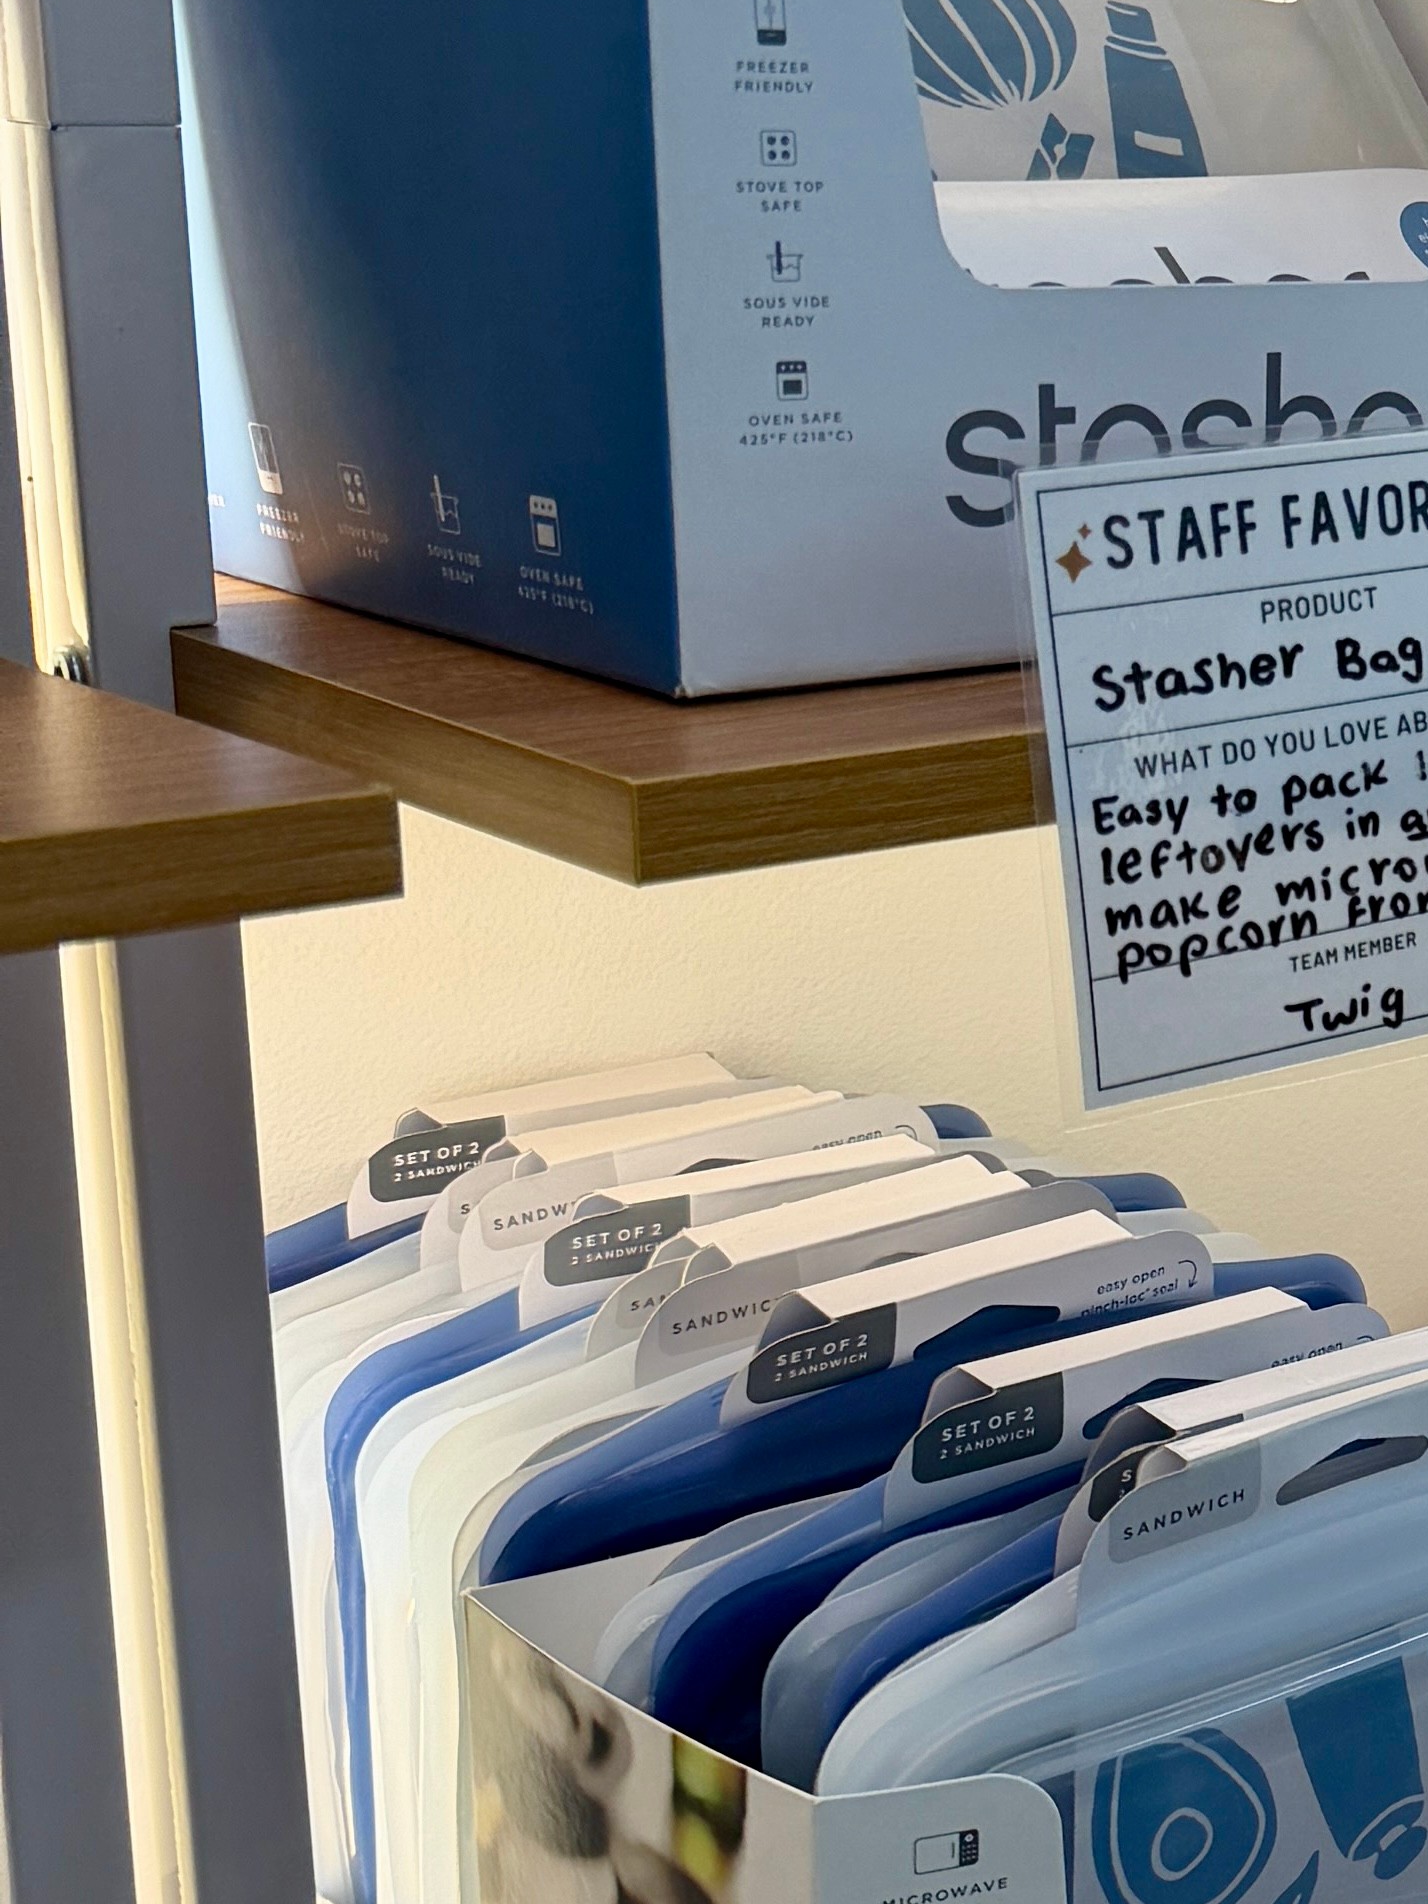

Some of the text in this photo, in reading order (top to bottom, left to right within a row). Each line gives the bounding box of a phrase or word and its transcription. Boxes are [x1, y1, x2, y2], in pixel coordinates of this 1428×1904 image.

[733, 80, 814, 95] FRIENDLY
[734, 60, 810, 75] FREEZER
[735, 180, 825, 195] STOVE TOP
[743, 295, 831, 310] SOUS VIDE
[748, 412, 844, 428] OVEN SAFE
[1102, 498, 1258, 571] STAFF
[1260, 585, 1379, 626] PRODUCT
[1092, 642, 1304, 713] Stasher
[1334, 635, 1425, 684] Bag
[1134, 743, 1213, 780] WHAT
[1222, 737, 1257, 764] DO
[1264, 727, 1317, 760] YOU
[1325, 717, 1389, 750] LOVE
[1091, 792, 1191, 837] Easy
[1209, 779, 1258, 818] to
[1282, 757, 1389, 807] pack
[1100, 816, 1325, 886] leftovers
[1345, 808, 1380, 841] in
[1104, 880, 1243, 936] make
[1115, 906, 1319, 985] popcorn
[1288, 930, 1418, 974] TEAM MEMBER
[1283, 983, 1406, 1034] Twig
[393, 1140, 481, 1169] SET OF 2
[1122, 1487, 1248, 1542] SANDWICH
